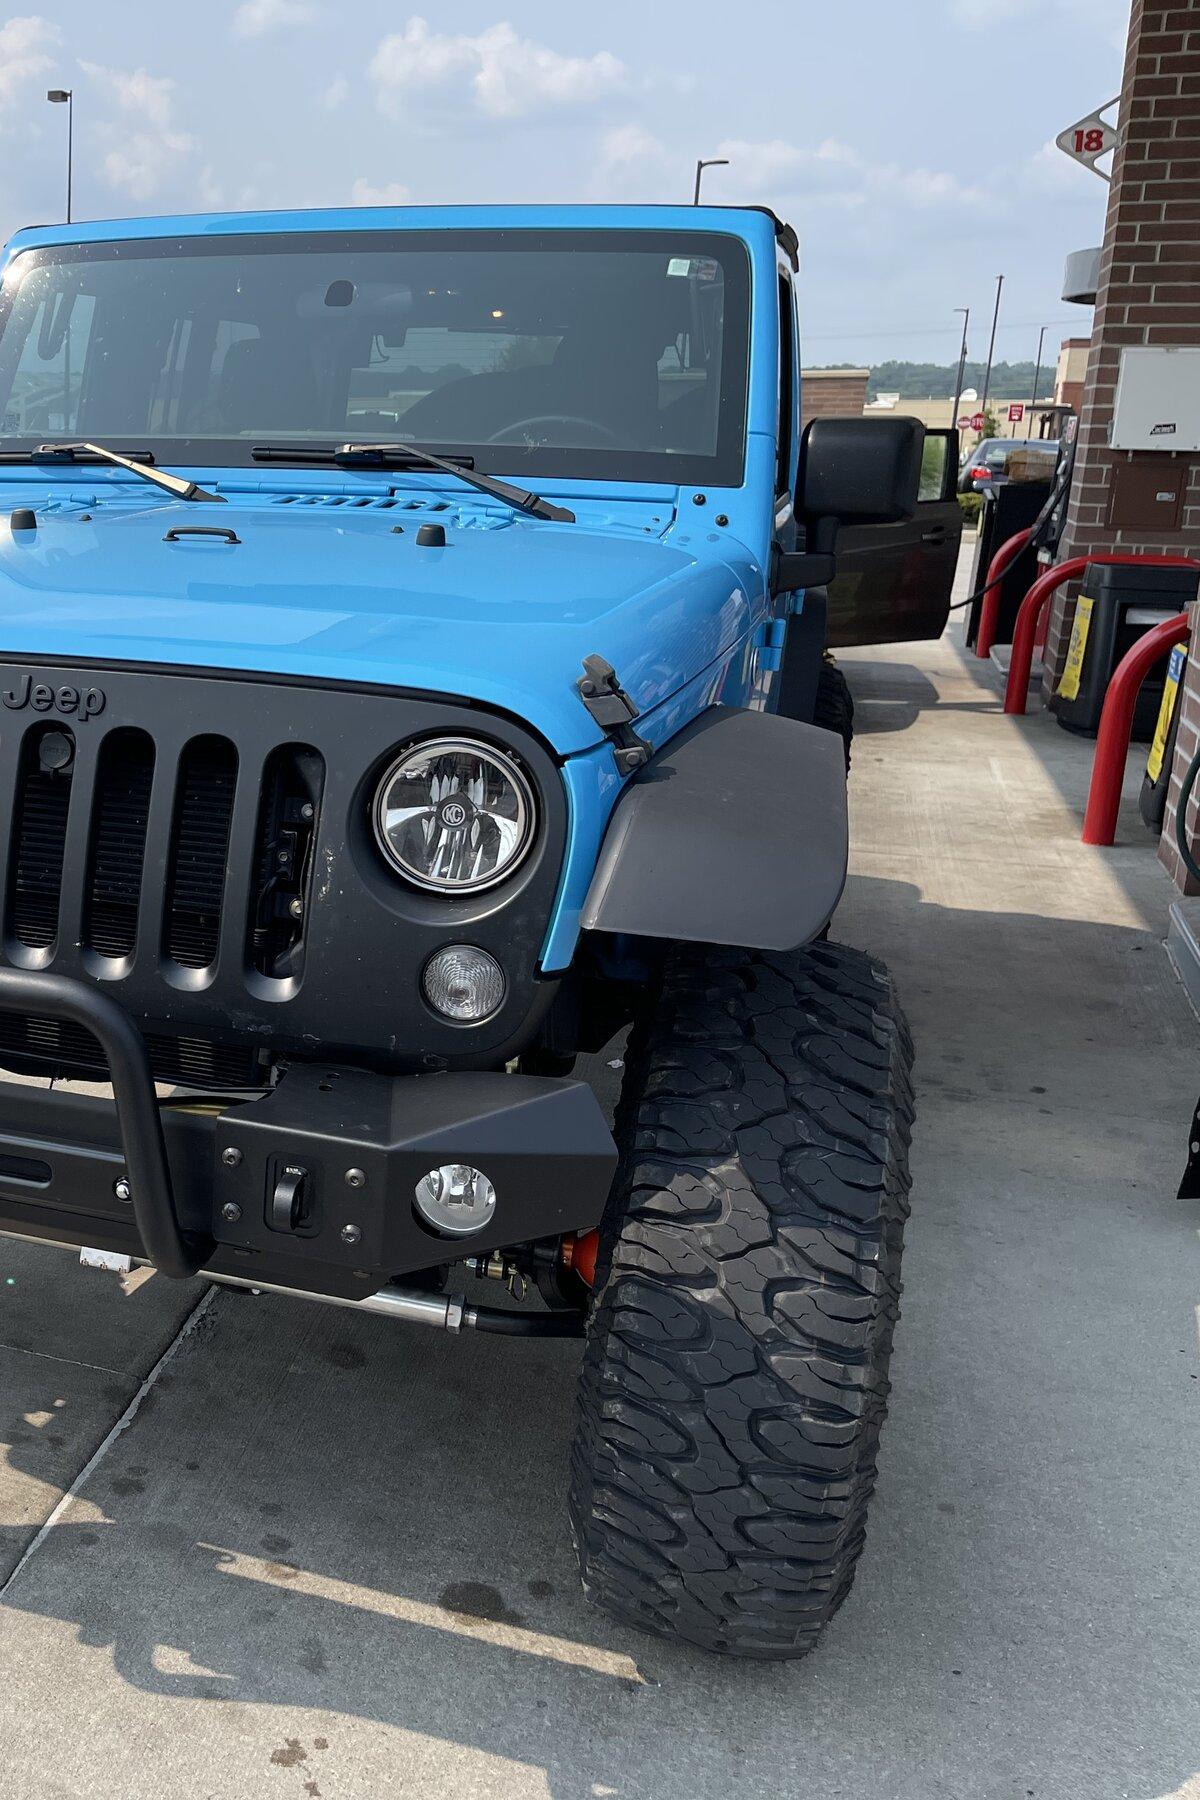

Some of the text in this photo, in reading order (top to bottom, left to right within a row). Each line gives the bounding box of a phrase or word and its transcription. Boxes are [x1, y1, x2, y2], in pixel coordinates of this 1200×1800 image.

[1074, 129, 1104, 152] 18
[2, 674, 107, 722] Jeep
[445, 805, 462, 824] KC
